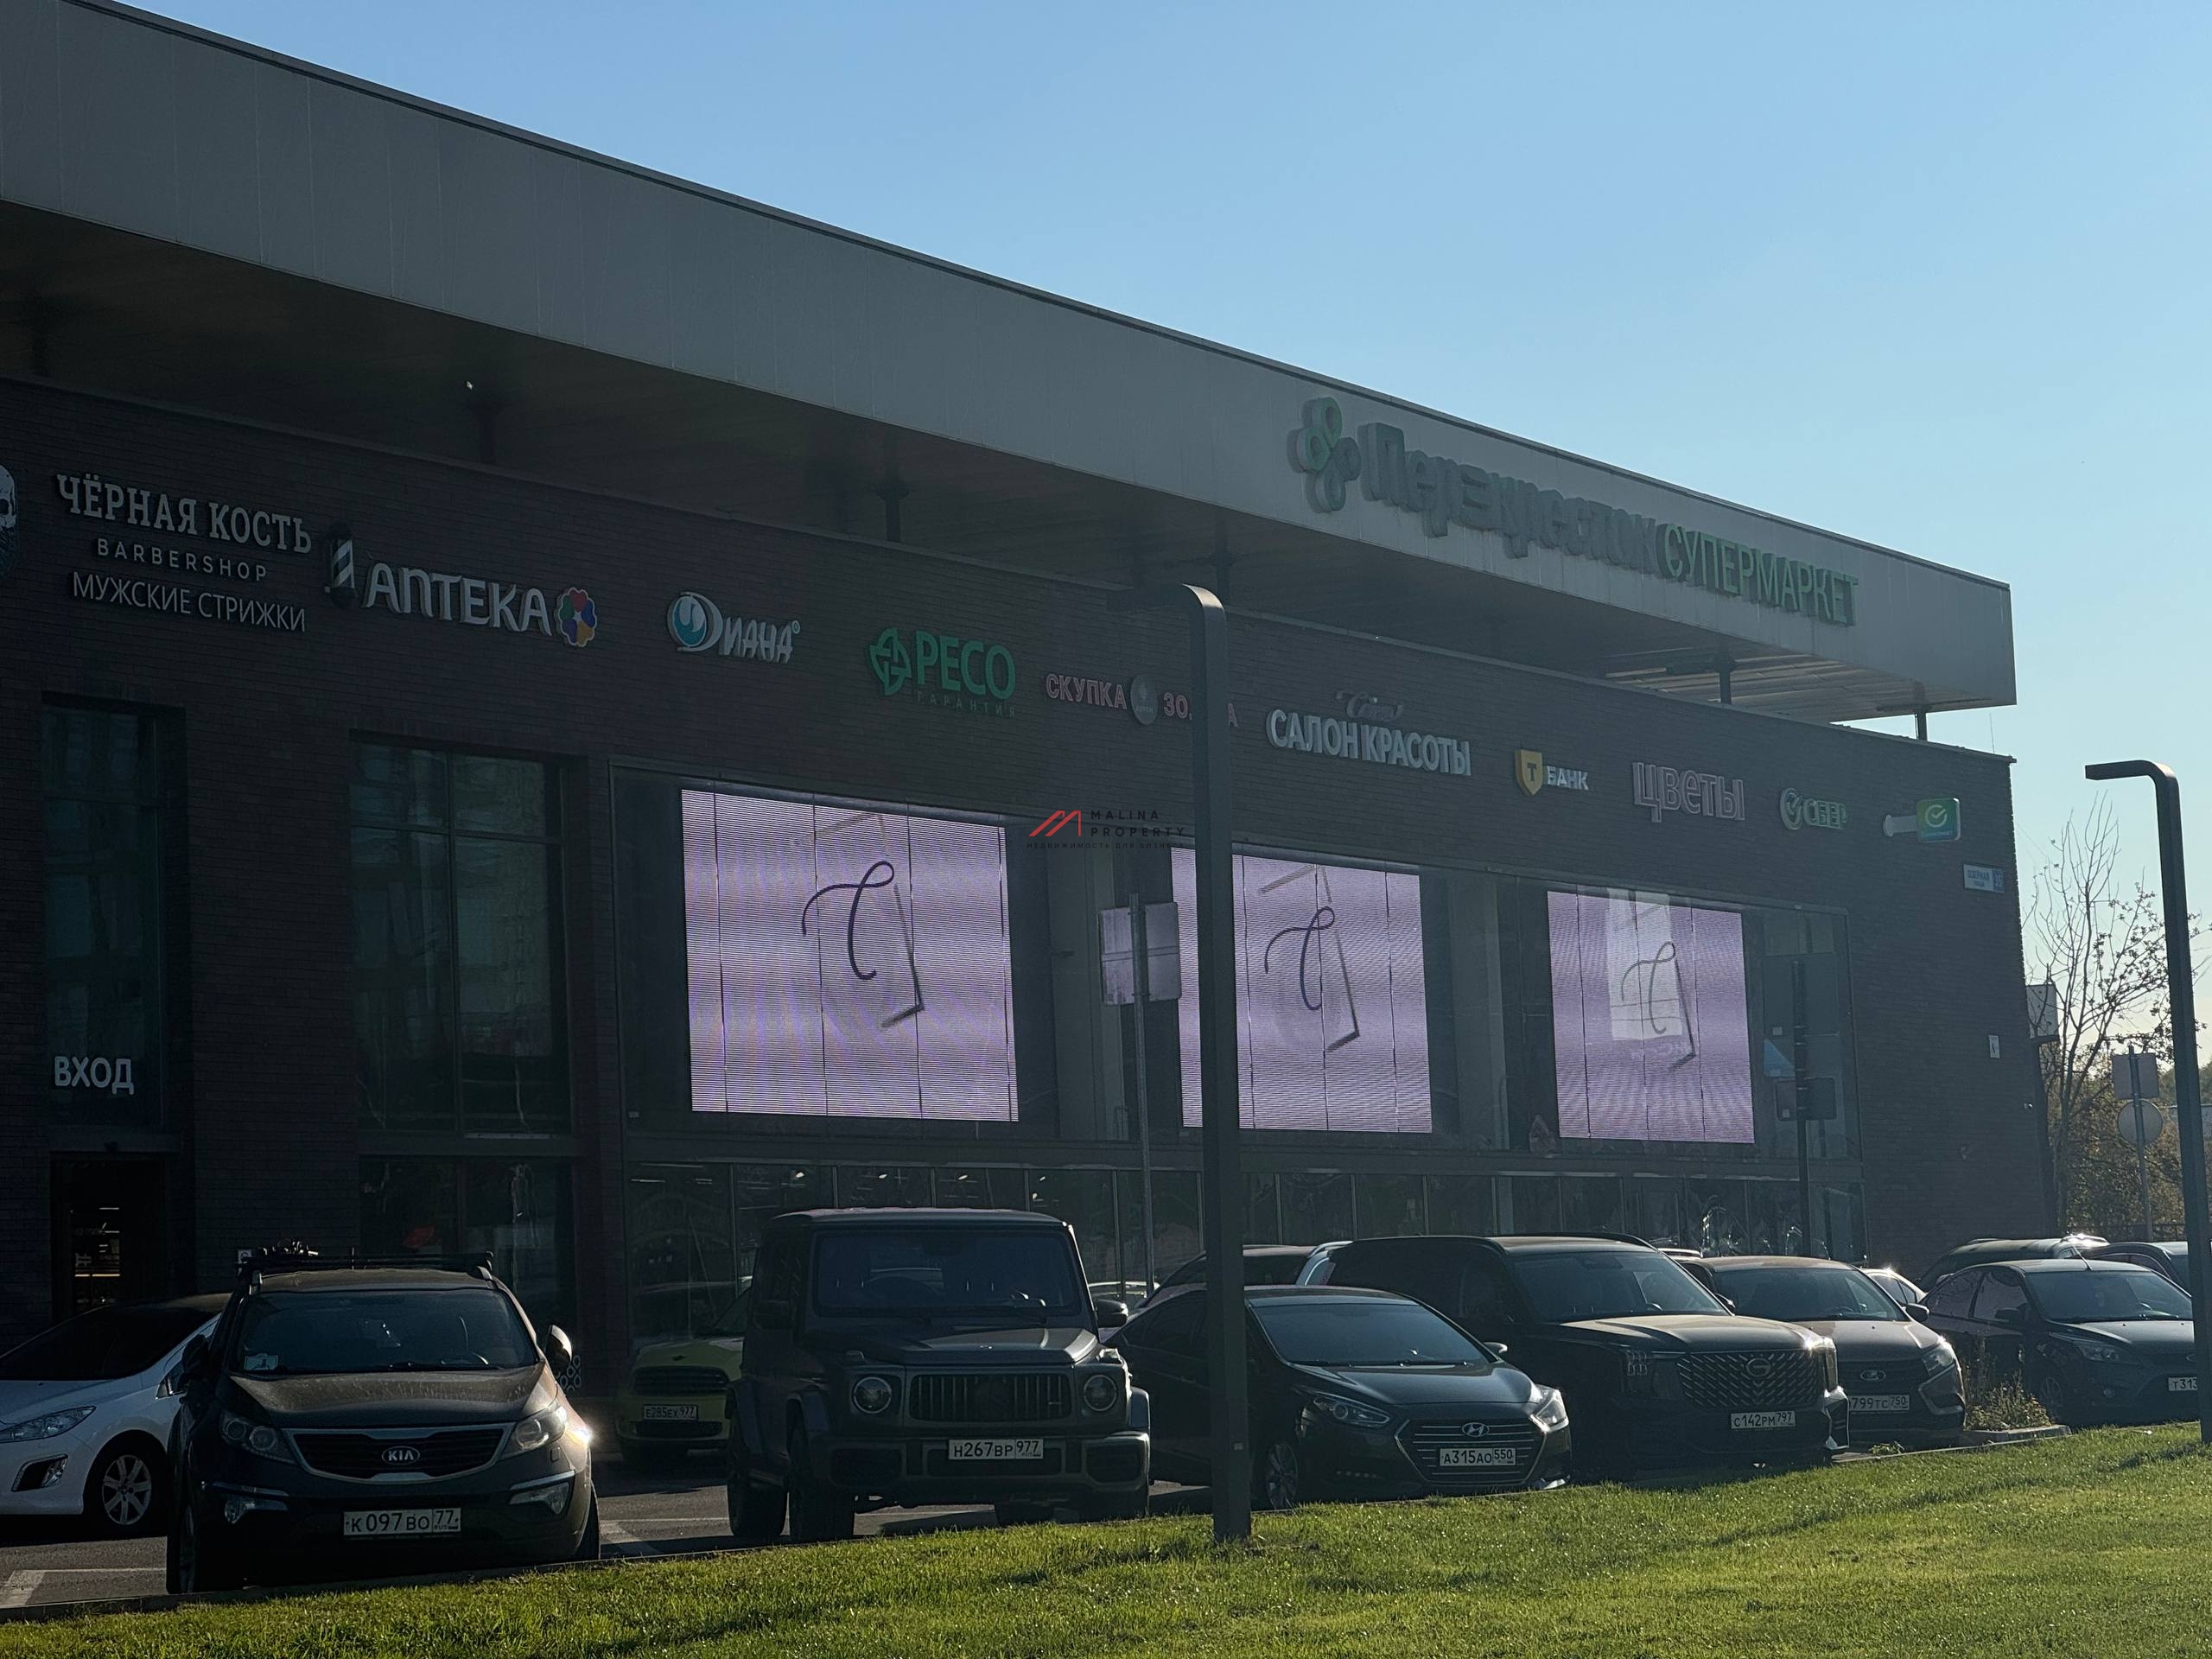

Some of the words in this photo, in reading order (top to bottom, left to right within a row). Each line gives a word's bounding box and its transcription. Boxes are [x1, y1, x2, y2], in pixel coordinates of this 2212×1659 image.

[56, 474, 198, 535] ЧЁРНАЯ
[208, 501, 312, 554] КОСТЬ
[97, 537, 267, 582] BARBERSHOP
[1658, 522, 1859, 626] СУПЕРМАРКЕТ
[73, 571, 191, 614] МУЖСКИЕ
[198, 592, 306, 632] СТРИЖКИ
[364, 563, 552, 637] АПТЕКА
[915, 629, 1016, 700] РЕСО
[917, 691, 1017, 718] ГАРАНТИЯ
[1046, 673, 1128, 710] СКУПКА
[1162, 691, 1238, 728] ЗОА
[1266, 709, 1359, 760] САЛОН
[1360, 724, 1471, 776] КРАСОТЫ
[1545, 765, 1590, 791] БАНК
[54, 1056, 134, 1095] ВХОД
[2172, 1378, 2199, 1389] Т313
[1733, 1414, 1776, 1427] С142РМ
[1776, 1411, 1792, 1422] 797
[1851, 1397, 1889, 1409] 799ТС
[388, 1450, 414, 1461] KIA
[953, 1441, 1014, 1458] Н267ВР
[1016, 1440, 1039, 1452] 977
[1443, 1449, 1492, 1464] А315АО
[1494, 1448, 1513, 1459] 550
[351, 1512, 430, 1533] К097ВО
[435, 1510, 454, 1524] 77
